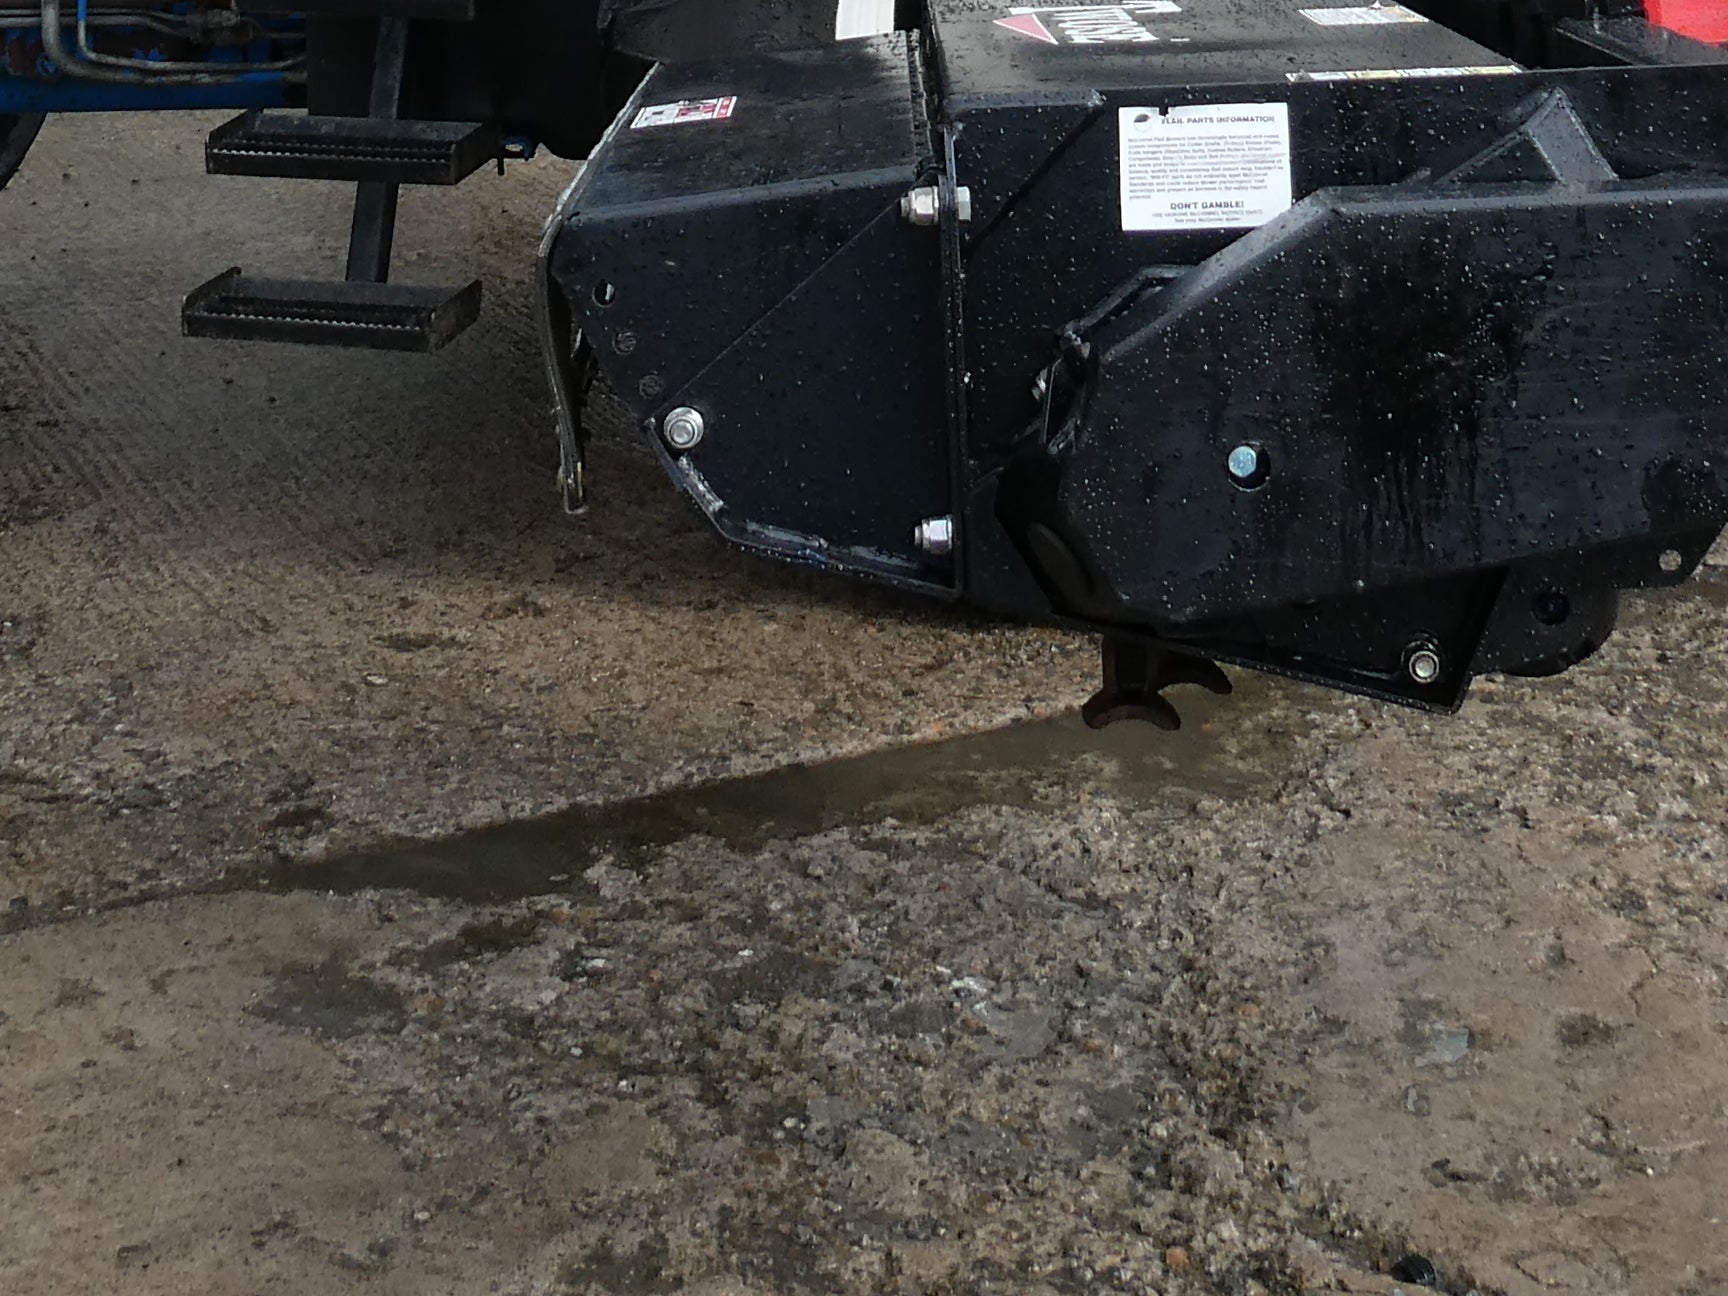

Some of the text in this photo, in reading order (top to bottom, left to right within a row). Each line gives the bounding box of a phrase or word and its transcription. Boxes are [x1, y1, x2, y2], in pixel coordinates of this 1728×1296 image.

[1187, 116, 1215, 124] PARTS
[1216, 115, 1275, 123] INFORMATION
[1170, 199, 1245, 211] DON'T GAMBLE!
